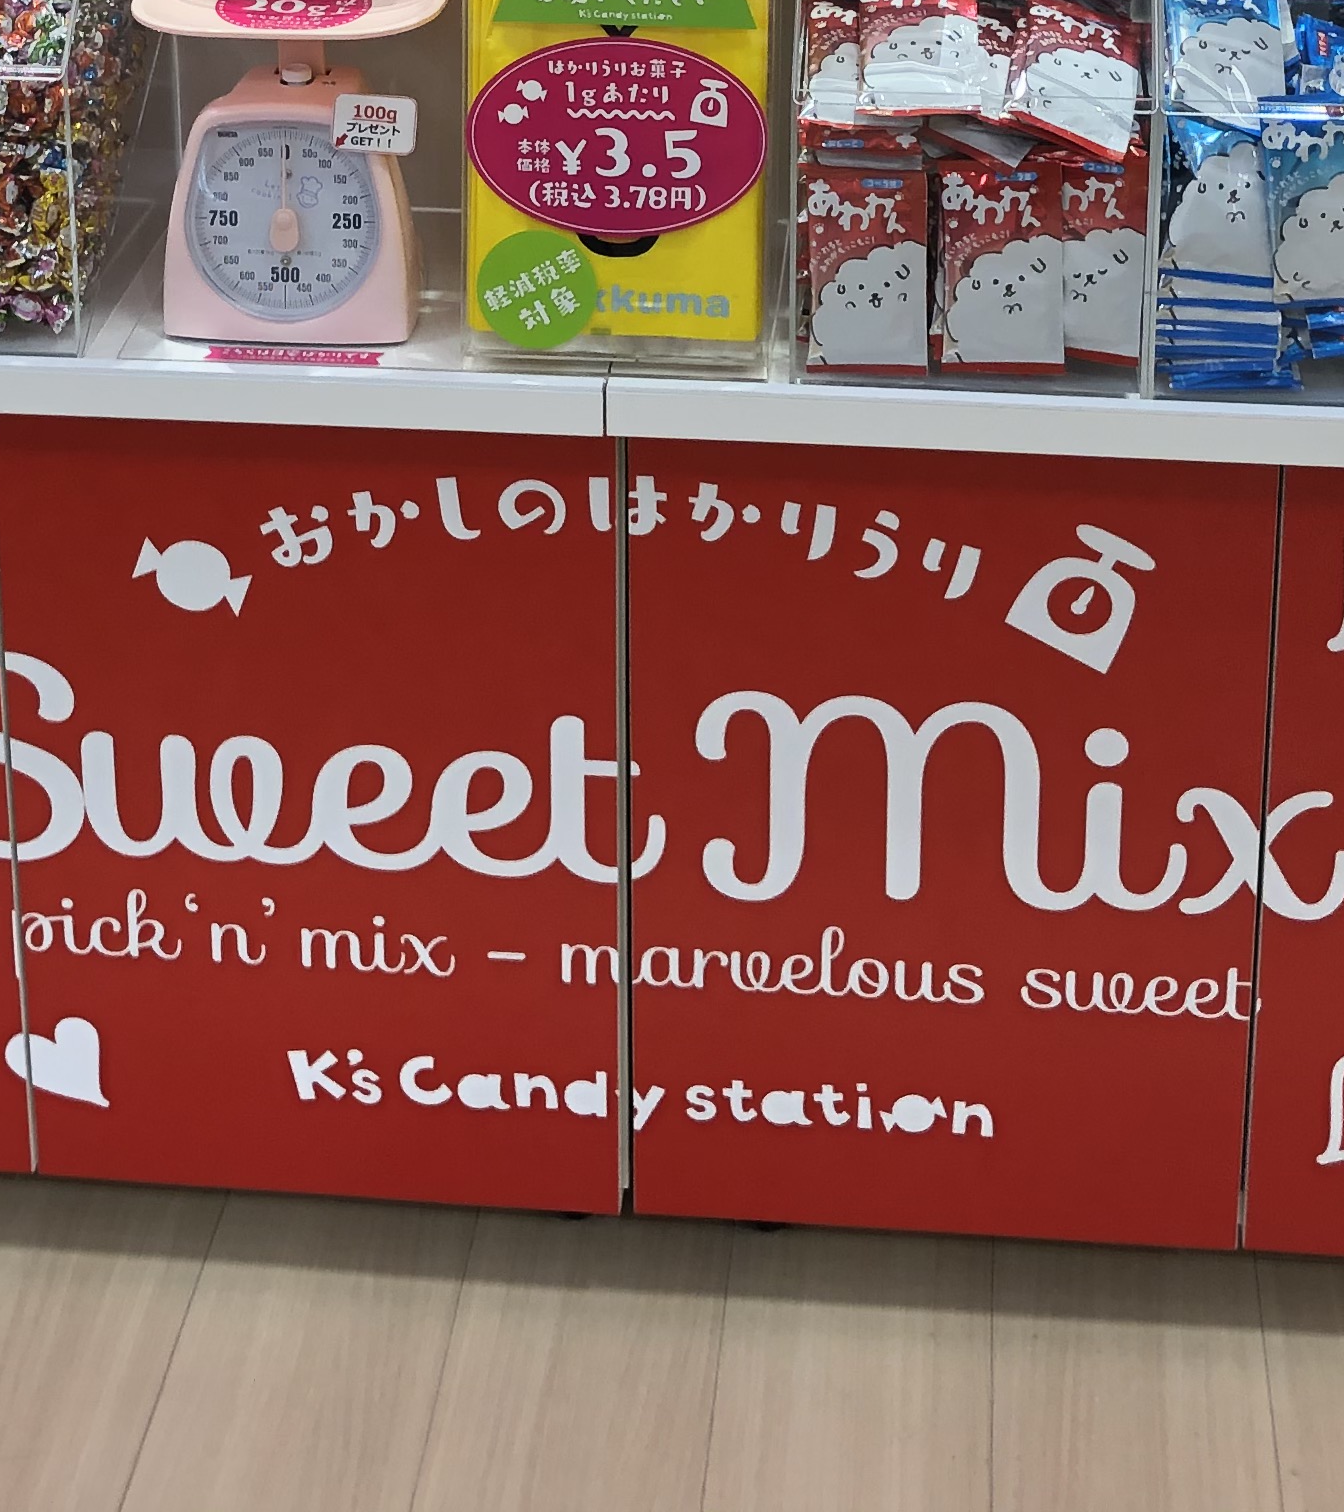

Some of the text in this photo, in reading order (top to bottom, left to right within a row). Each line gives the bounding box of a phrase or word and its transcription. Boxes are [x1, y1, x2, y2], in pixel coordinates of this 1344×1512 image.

[593, 8, 629, 22] Candy
[631, 11, 673, 21] station
[548, 58, 687, 78] はかりうりお菓子
[352, 104, 398, 124] 100g
[346, 122, 401, 136] プレゼント
[517, 138, 551, 155] 本体
[239, 157, 254, 167] 900
[318, 159, 332, 169] 100
[516, 156, 550, 174] 価格
[223, 171, 239, 181] 850
[333, 174, 347, 184] 150
[342, 195, 358, 205] 200
[208, 209, 239, 227] 750
[332, 213, 362, 230] 250
[212, 235, 229, 245] 700
[342, 239, 358, 249] 300
[223, 255, 240, 265] 650
[331, 258, 347, 268] 350
[239, 271, 255, 281] 600
[270, 266, 300, 283] 500
[315, 273, 332, 283] 400
[483, 246, 583, 314] 軽減税率
[257, 282, 274, 292] 550
[296, 283, 312, 293] 450
[517, 286, 582, 331] 対象
[259, 474, 982, 600] おかしのはかりうり
[10, 888, 182, 980] pick
[300, 915, 456, 978] mix
[560, 926, 986, 1005] marvelous
[1019, 962, 1263, 1021] sweet
[287, 1048, 995, 1138] K's Candy station
